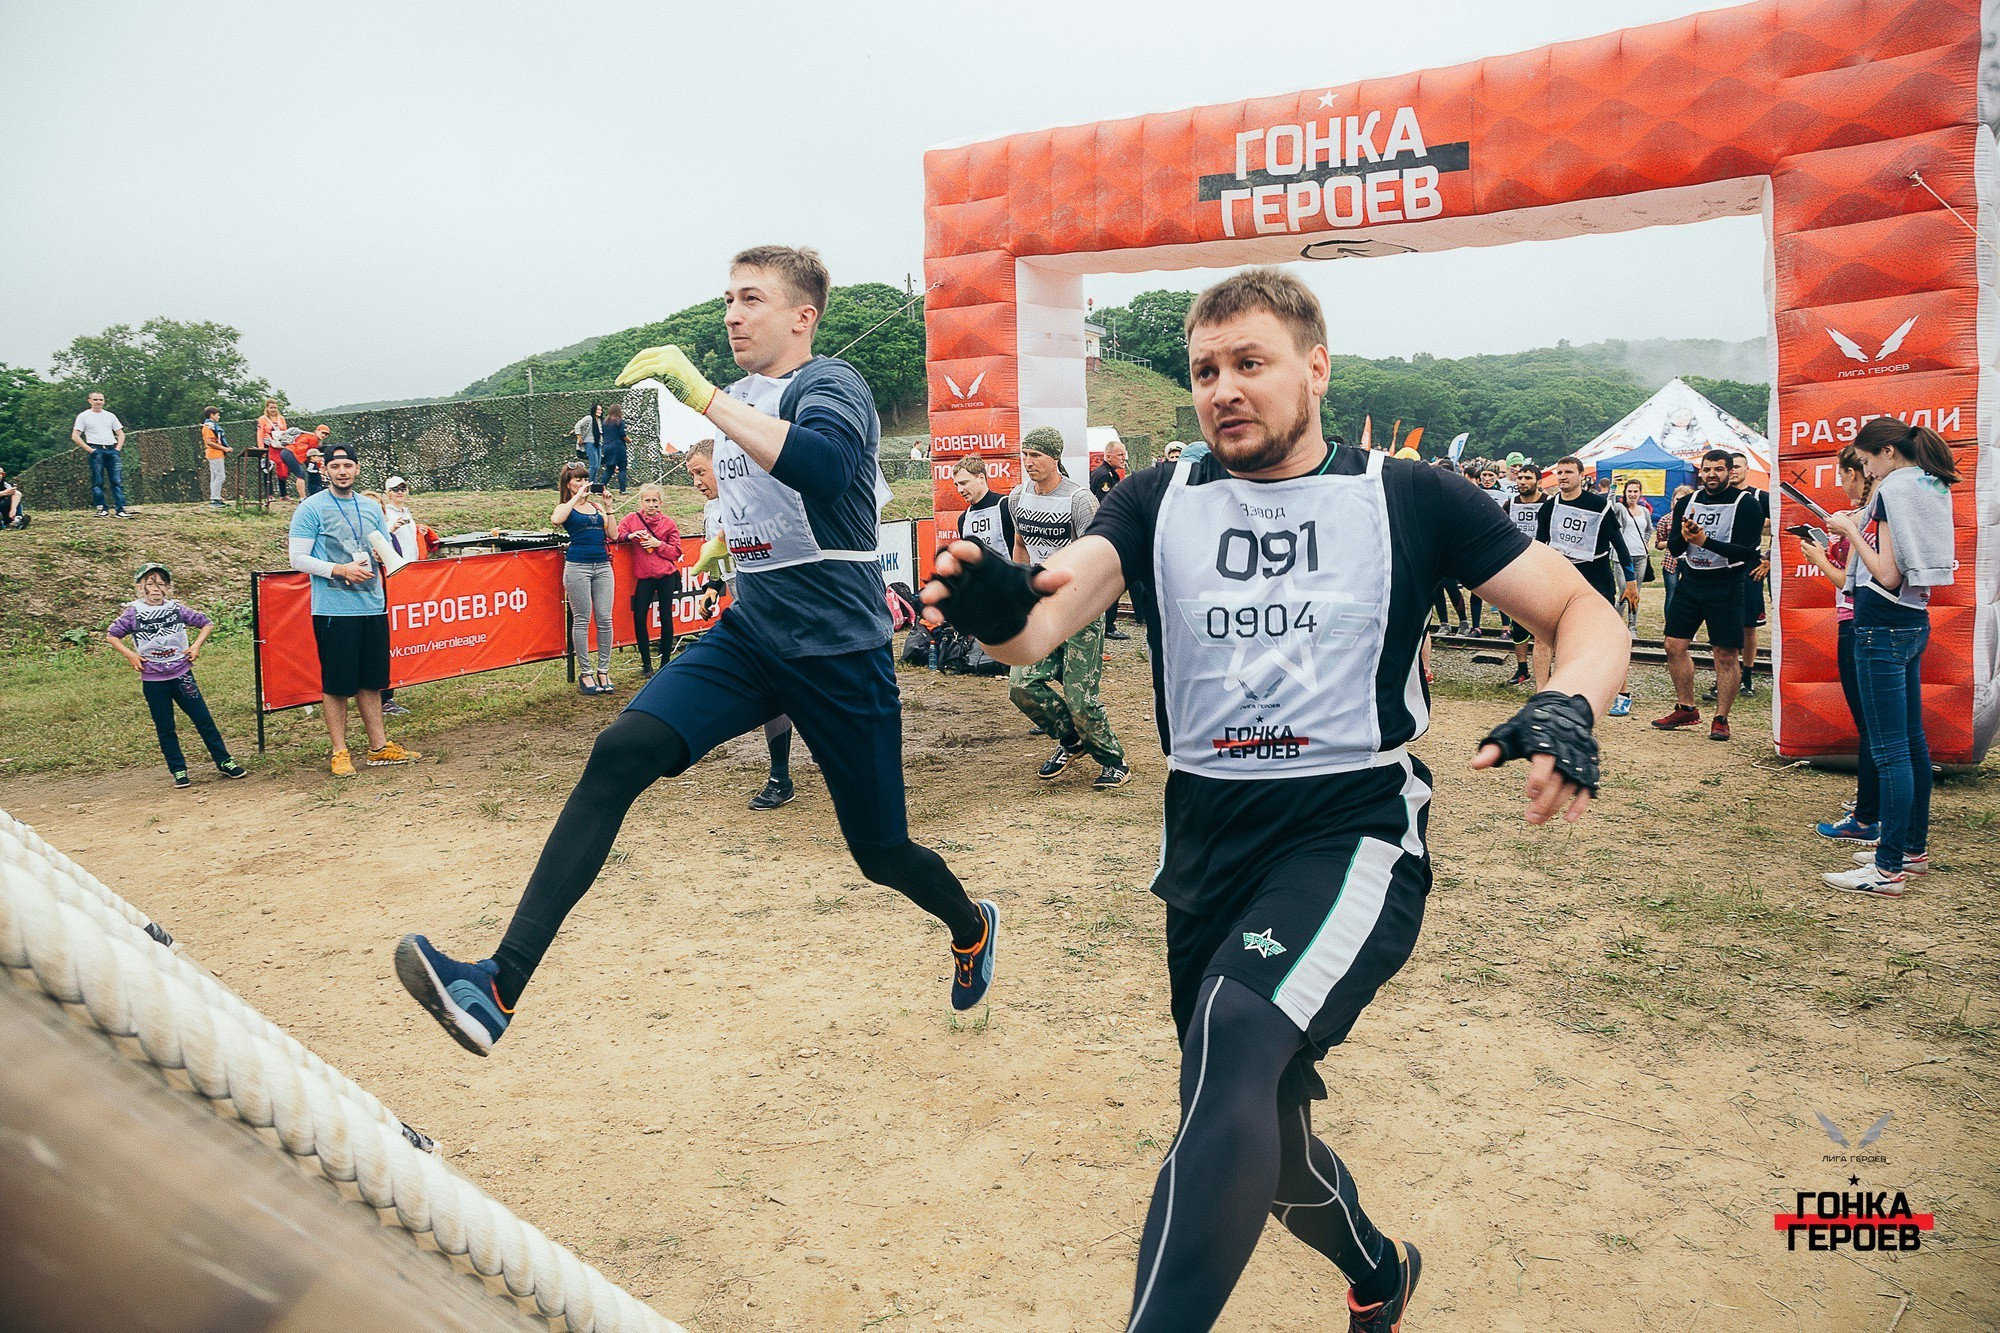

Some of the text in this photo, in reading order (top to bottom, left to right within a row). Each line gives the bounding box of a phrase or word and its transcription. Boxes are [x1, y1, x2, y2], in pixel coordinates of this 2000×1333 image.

[1236, 106, 1428, 181] ГОНКА
[1221, 165, 1443, 237] ГЕРОЕВ
[1837, 363, 1910, 379] ЛИГА ГЕРОЕВ
[934, 433, 1006, 452] СОВЕРШИ
[719, 454, 750, 480] 0901
[972, 518, 991, 533] 091
[1563, 516, 1588, 533] 091
[1696, 513, 1721, 526] 091
[1019, 522, 1066, 536] ИНСТРУКТОР
[1560, 532, 1583, 544] 0907
[729, 535, 763, 549] ГОНКА
[1216, 520, 1318, 581] 091
[879, 552, 899, 572] АНК
[1207, 601, 1317, 639] 0904
[1224, 725, 1295, 743] ГОНКА
